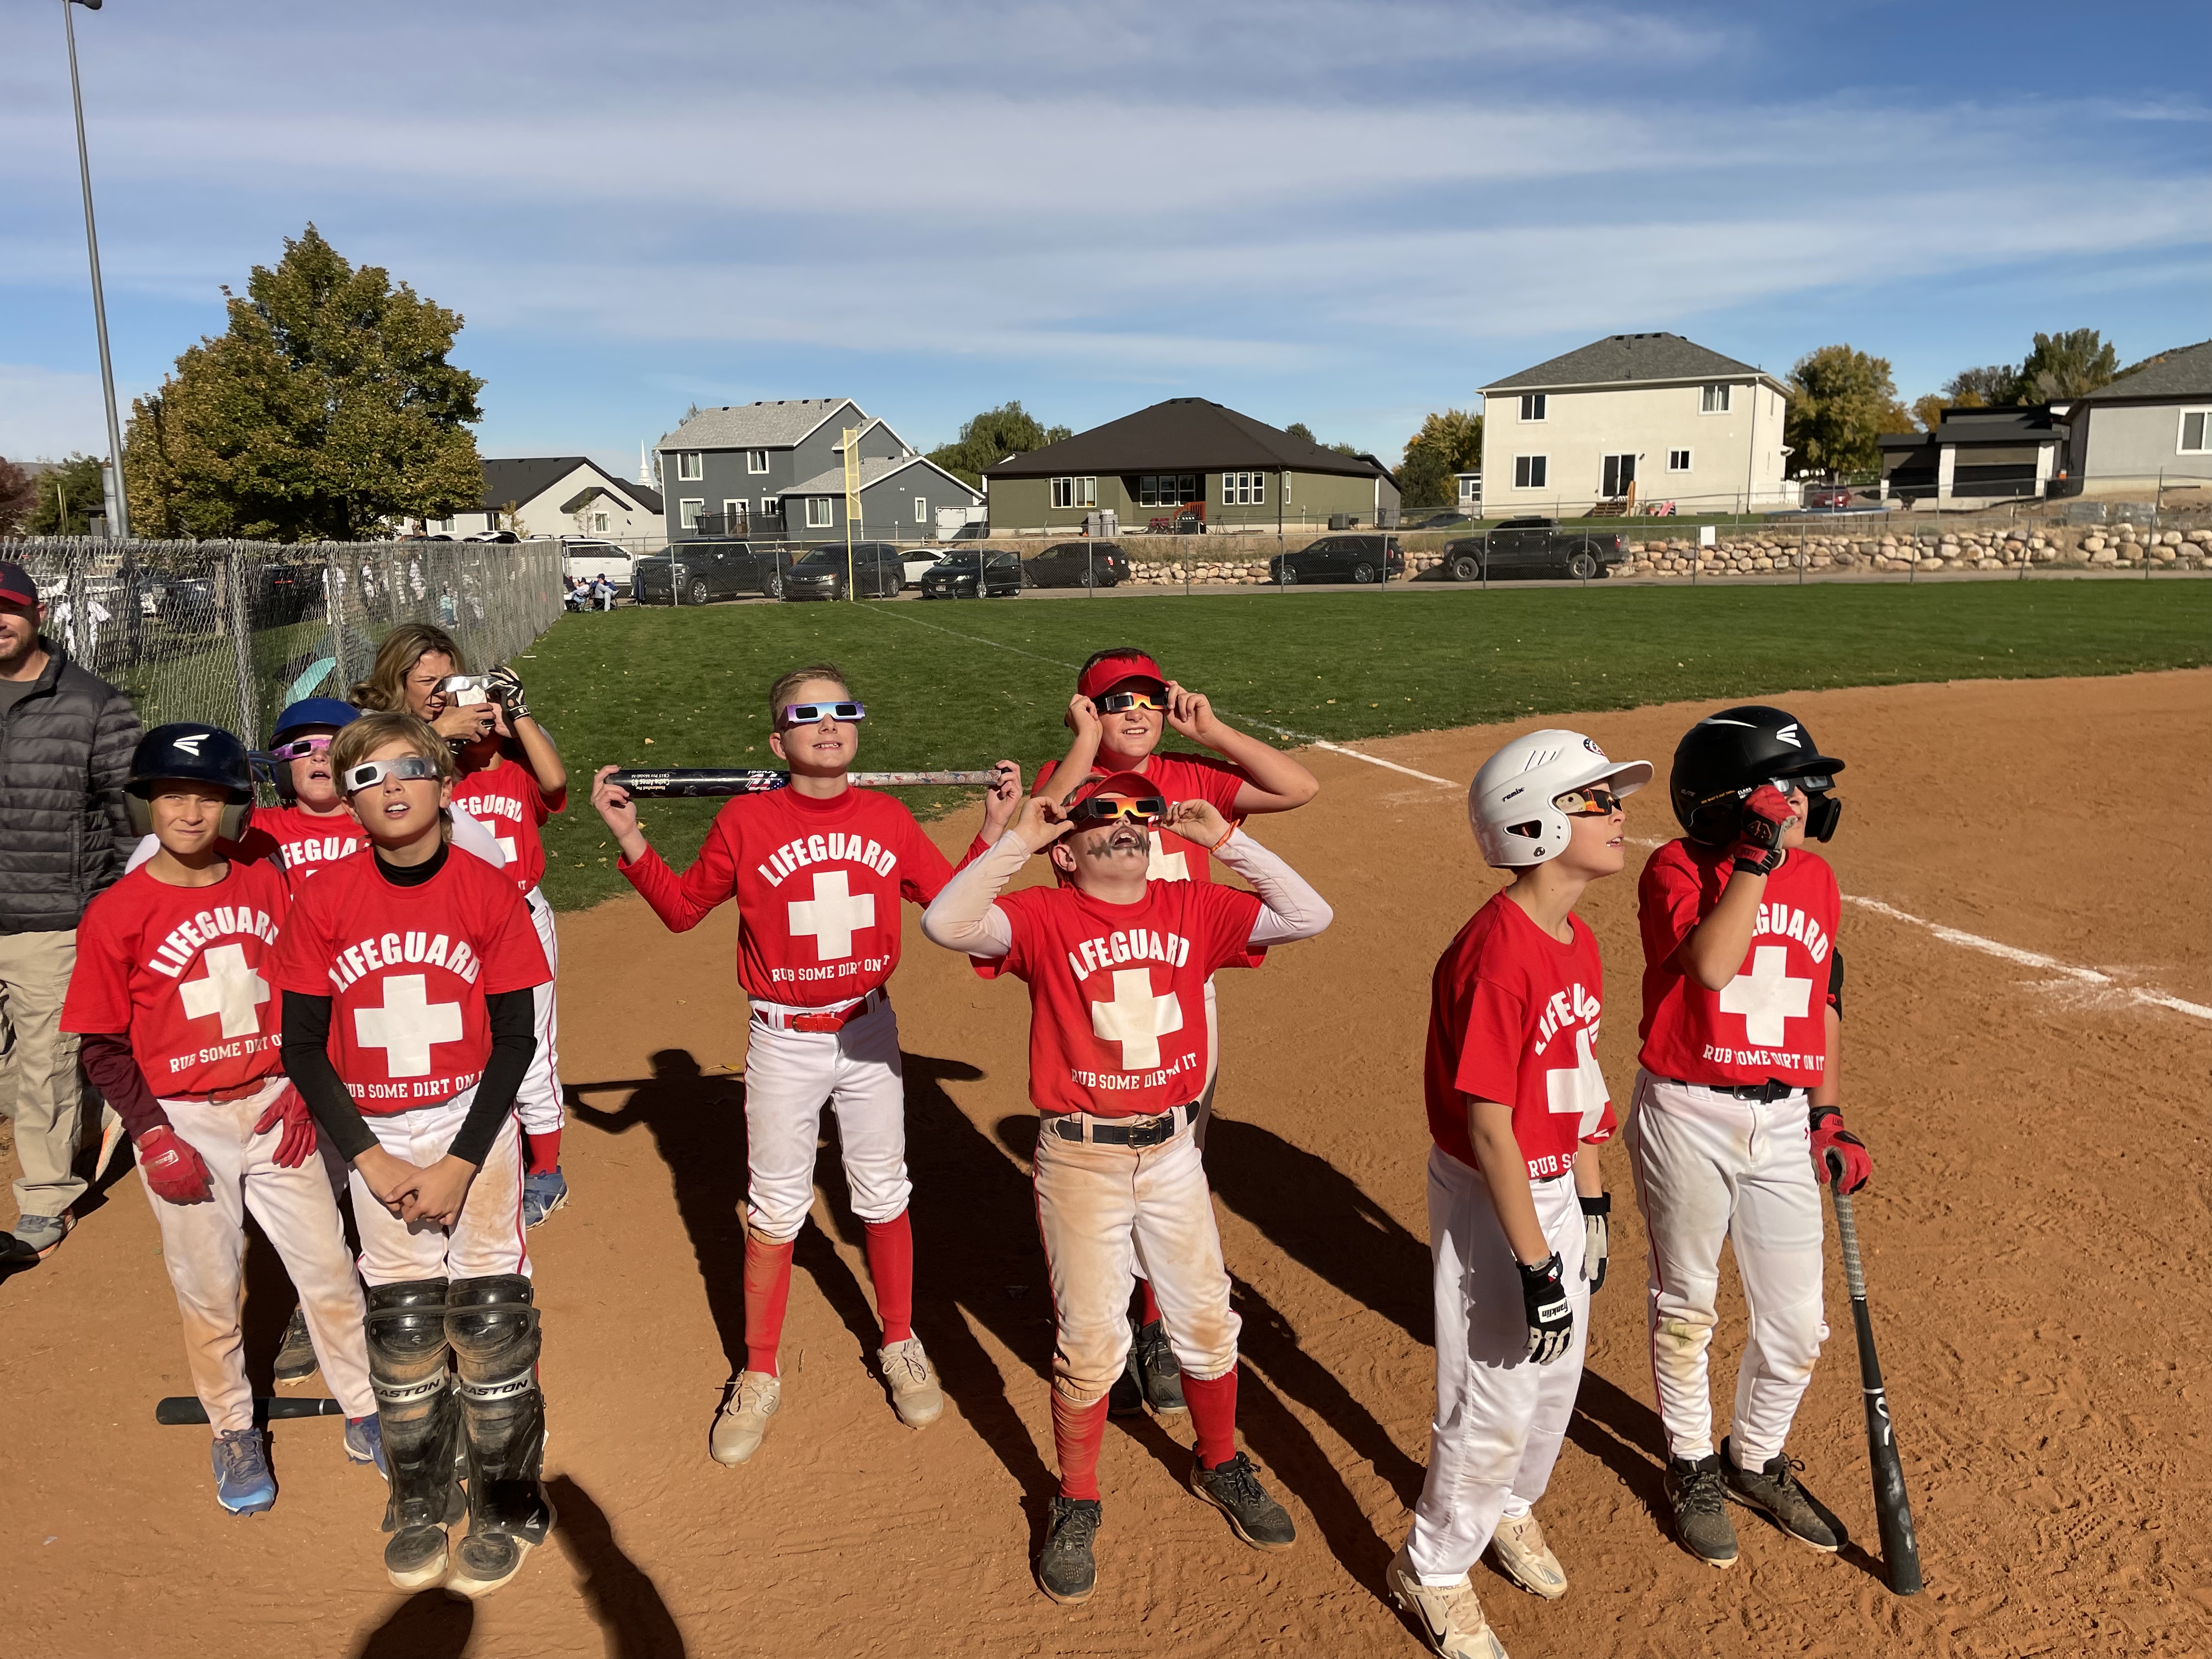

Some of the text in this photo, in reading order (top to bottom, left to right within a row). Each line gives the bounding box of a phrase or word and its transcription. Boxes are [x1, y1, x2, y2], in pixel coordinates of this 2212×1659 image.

[455, 794, 522, 822] EGUARD
[1501, 787, 1525, 802] remix
[280, 837, 357, 870] FEGUA
[758, 833, 896, 887] LIFEGUARD
[1752, 902, 1829, 964] GUARD
[329, 931, 479, 994] LIFEGUARD
[1068, 928, 1189, 981] LFEGUARD
[772, 968, 794, 982] RUB
[798, 966, 834, 981] SOME
[864, 958, 882, 972] ON
[170, 1053, 196, 1073] RUB
[200, 1042, 241, 1064] SOME
[271, 1033, 282, 1046] O
[1703, 1044, 1732, 1064] RUB
[1770, 1052, 1801, 1069] DIRT
[1803, 1054, 1814, 1070] ON
[1815, 1055, 1825, 1071] IT
[1071, 1068, 1097, 1087] RUB
[1099, 1074, 1139, 1090] SOME
[1181, 1052, 1197, 1070] IT
[368, 1083, 408, 1098] SOME
[413, 1078, 449, 1097] DIRT
[455, 1073, 475, 1091] ON
[1528, 1152, 1578, 1178] RUB SO
[373, 1379, 441, 1398] EASTON
[463, 1379, 528, 1396] EASTON
